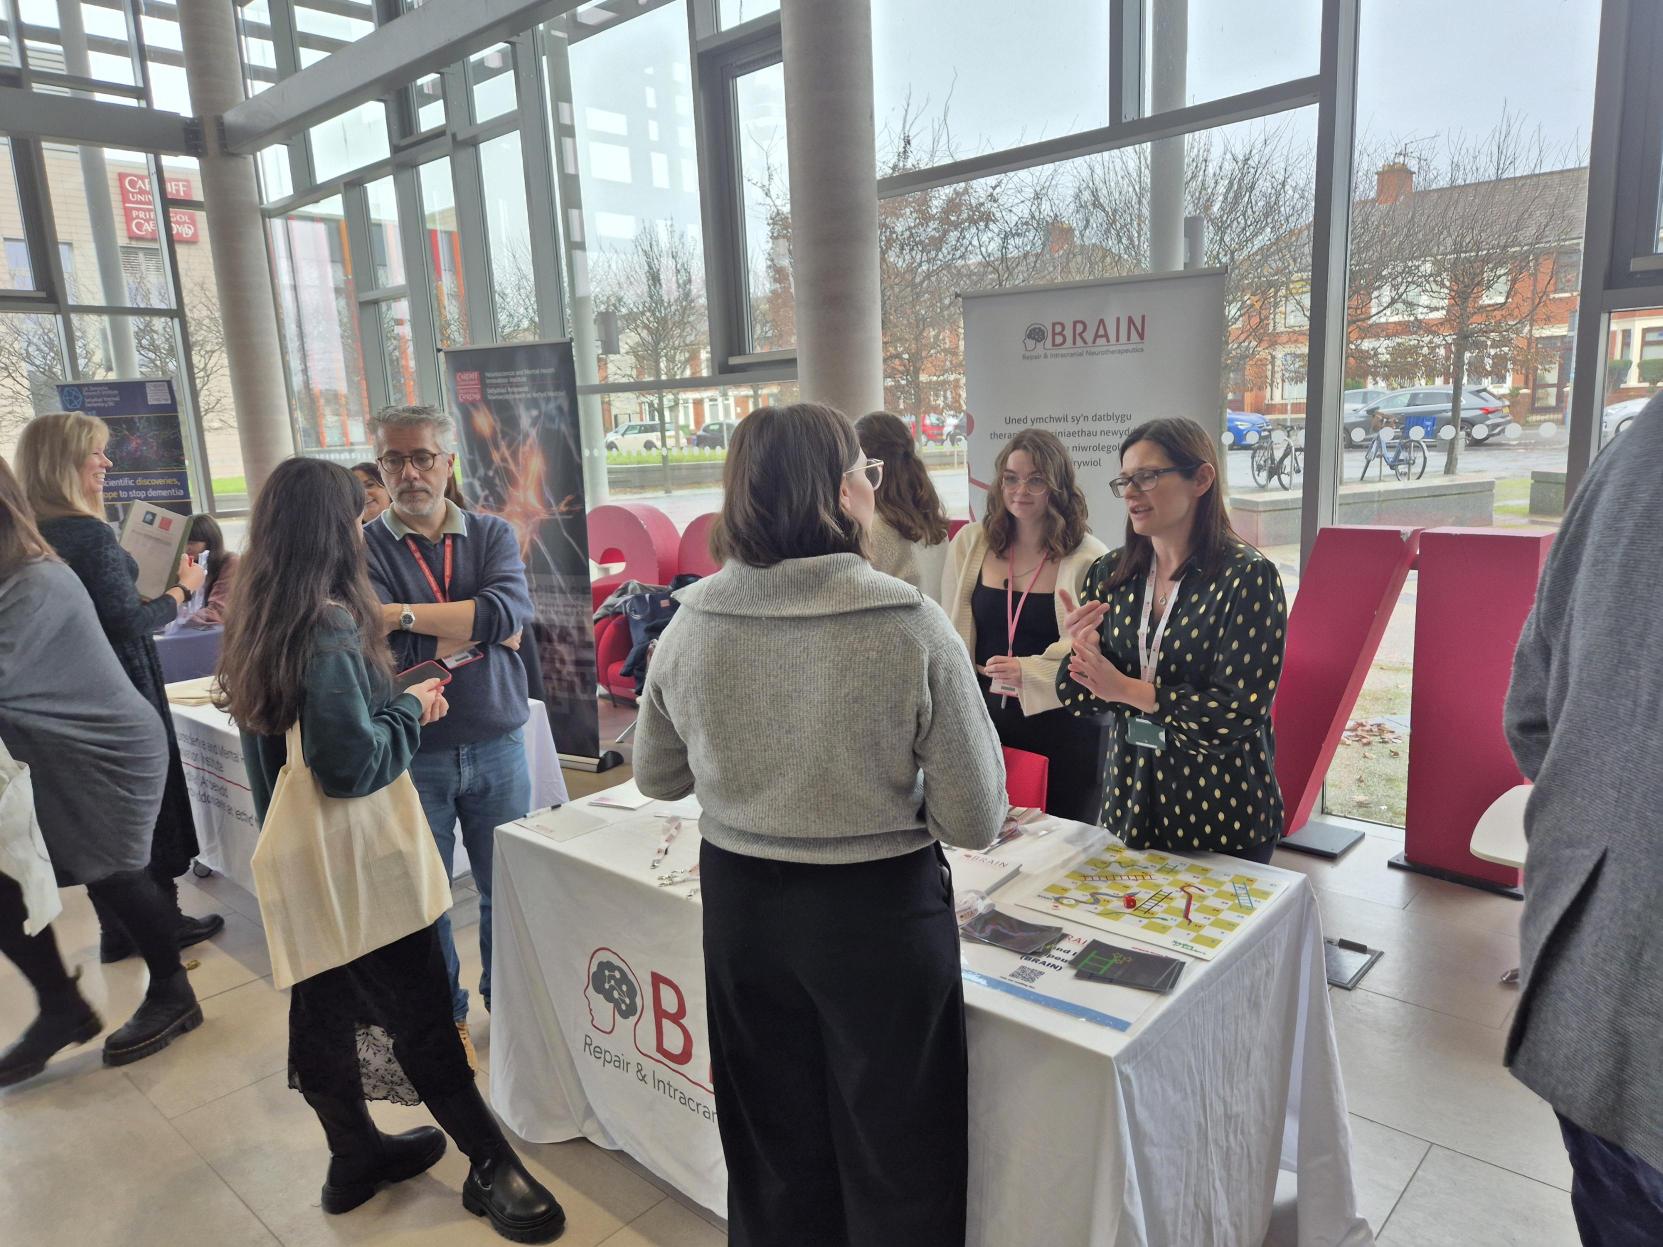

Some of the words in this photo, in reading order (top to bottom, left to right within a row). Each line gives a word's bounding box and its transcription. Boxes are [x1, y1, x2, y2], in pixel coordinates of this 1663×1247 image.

[1051, 314, 1146, 348] BRAIN
[1004, 415, 1028, 425] Uned
[1031, 413, 1069, 426] ymchwil
[1071, 413, 1089, 425] sy'n
[1092, 412, 1132, 424] datblygu
[103, 491, 118, 499] ope
[119, 490, 128, 498] to
[129, 489, 147, 499] stop
[147, 487, 184, 497] dementia
[583, 1034, 631, 1073] Repair
[636, 1062, 648, 1085] &
